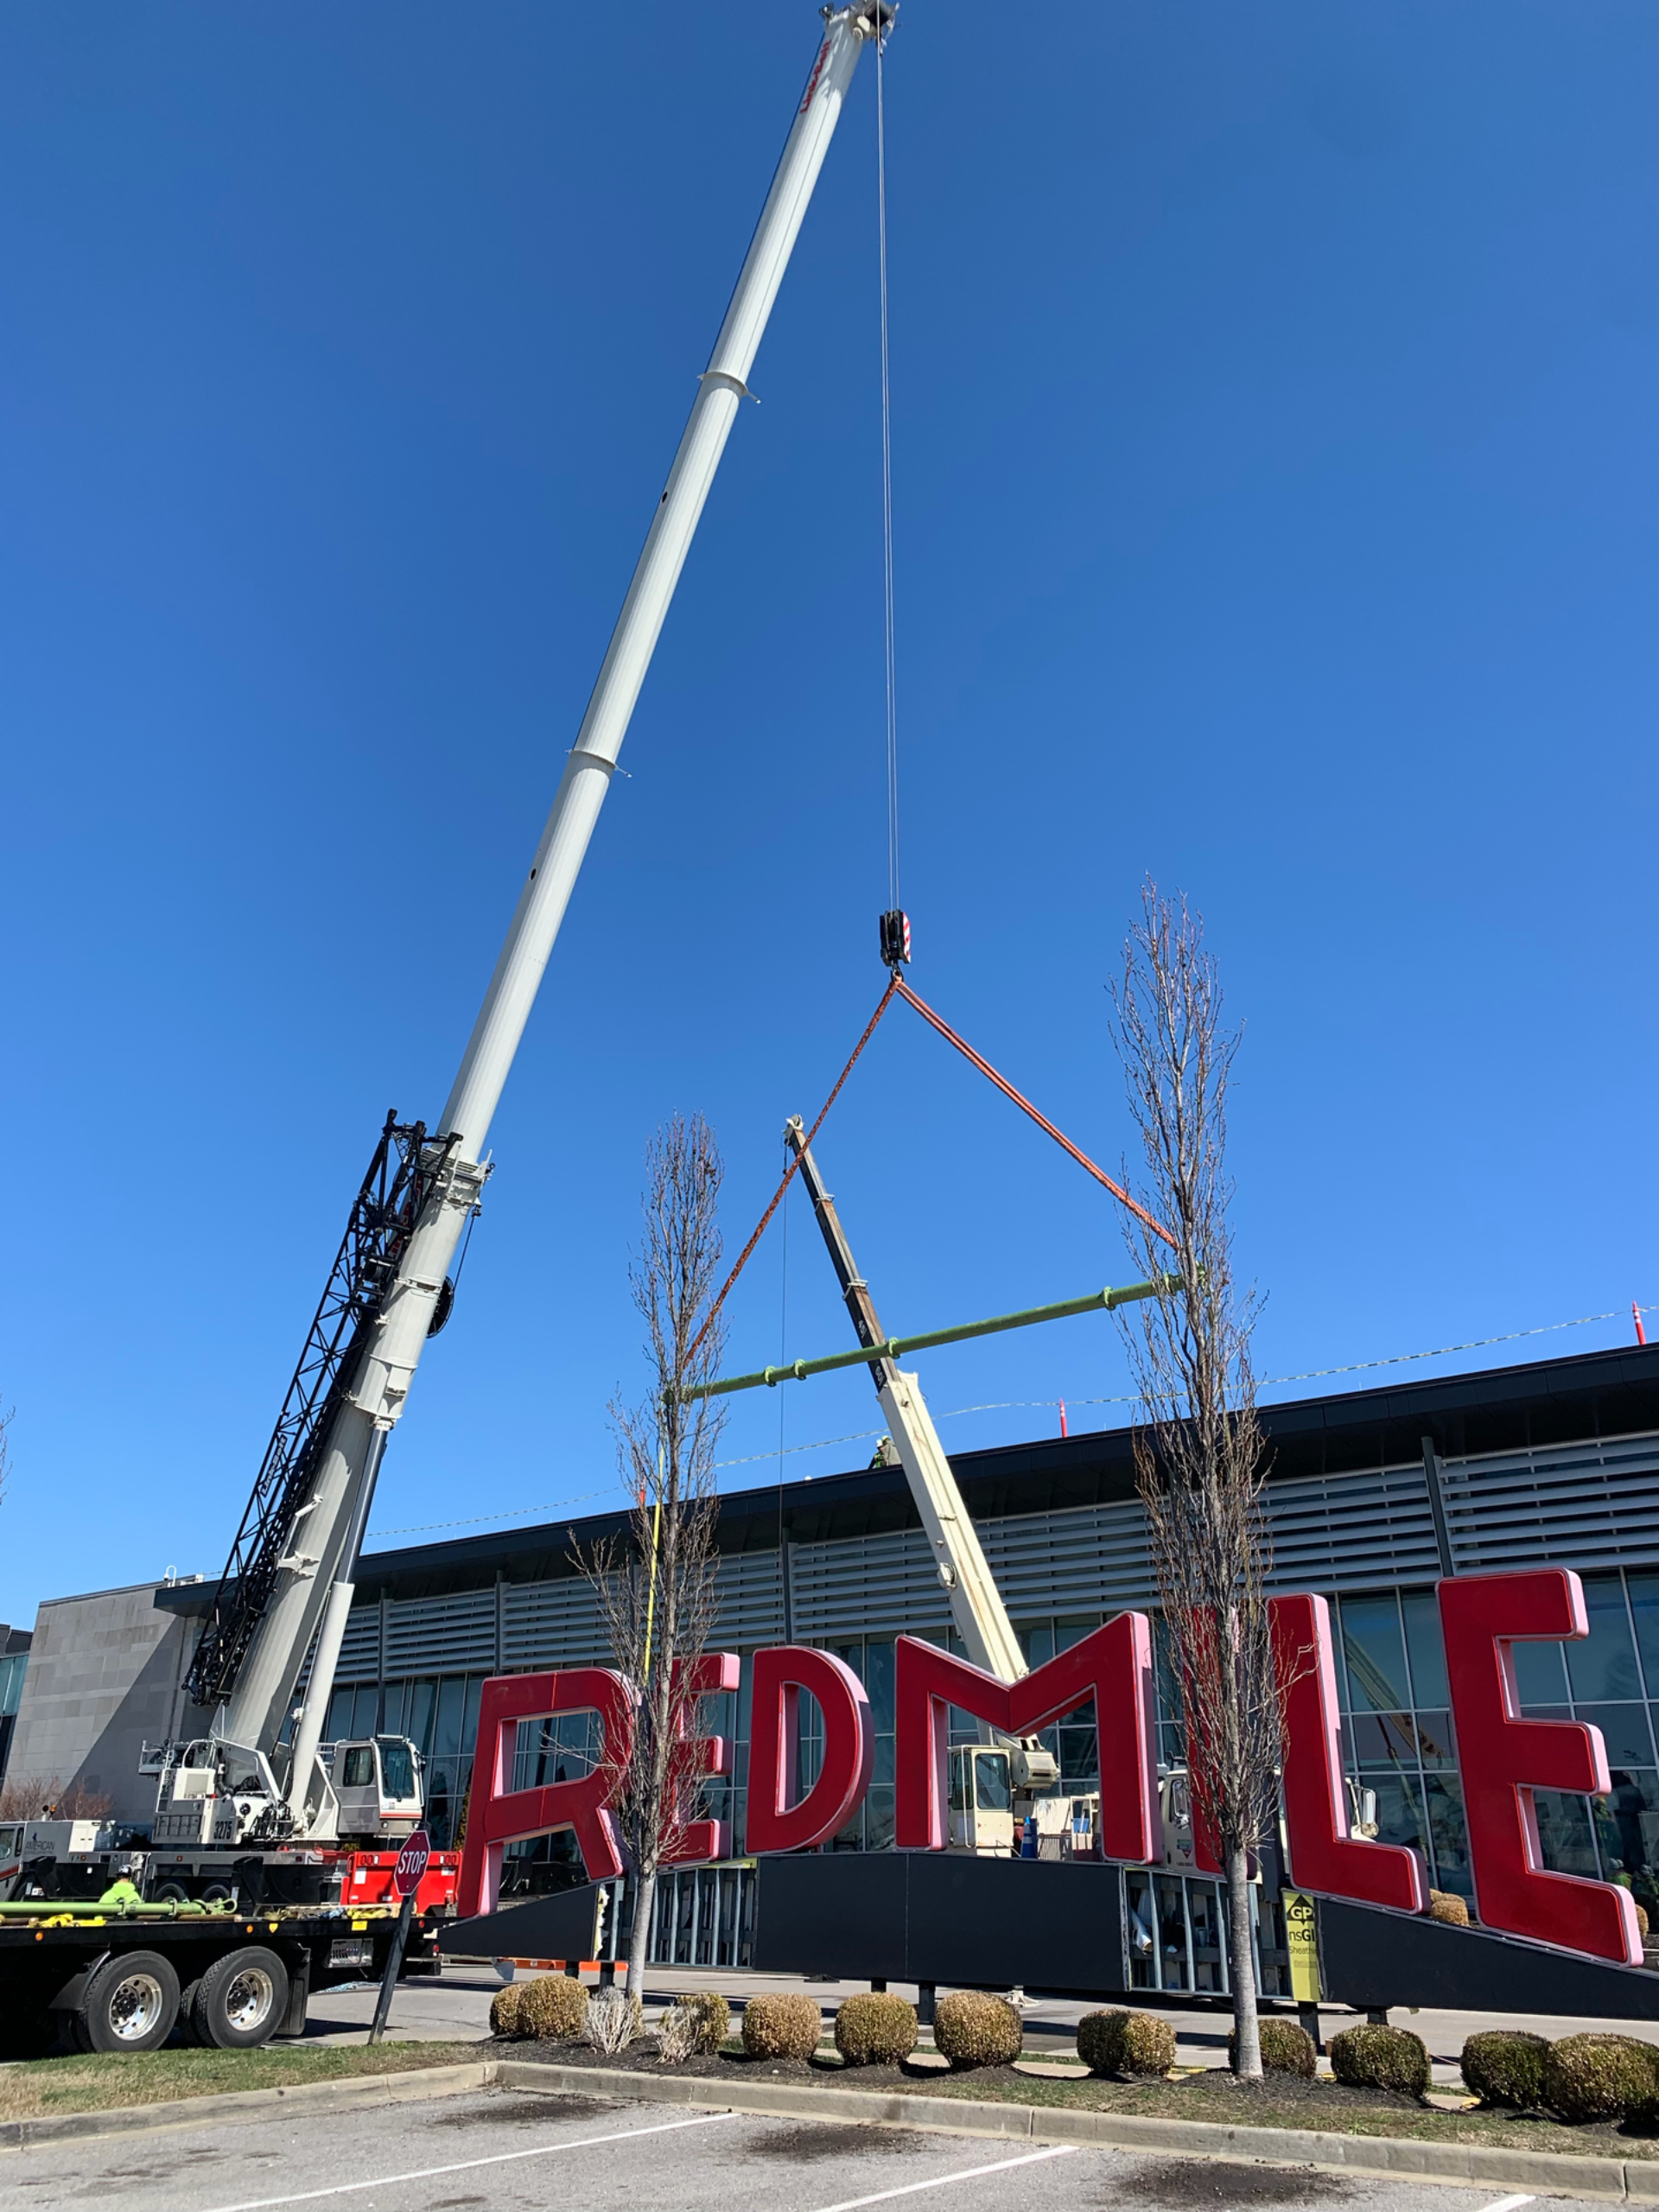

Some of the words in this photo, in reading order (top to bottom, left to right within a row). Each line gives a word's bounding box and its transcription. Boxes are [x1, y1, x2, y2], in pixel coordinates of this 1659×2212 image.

[261, 1436, 287, 1496] Link-Belt
[458, 1566, 1644, 1967] REDMILE
[213, 1821, 232, 1840] 3275
[25, 1840, 55, 1850] AMERICAN
[398, 1851, 427, 1874] STOP
[1290, 1906, 1313, 1920] GP
